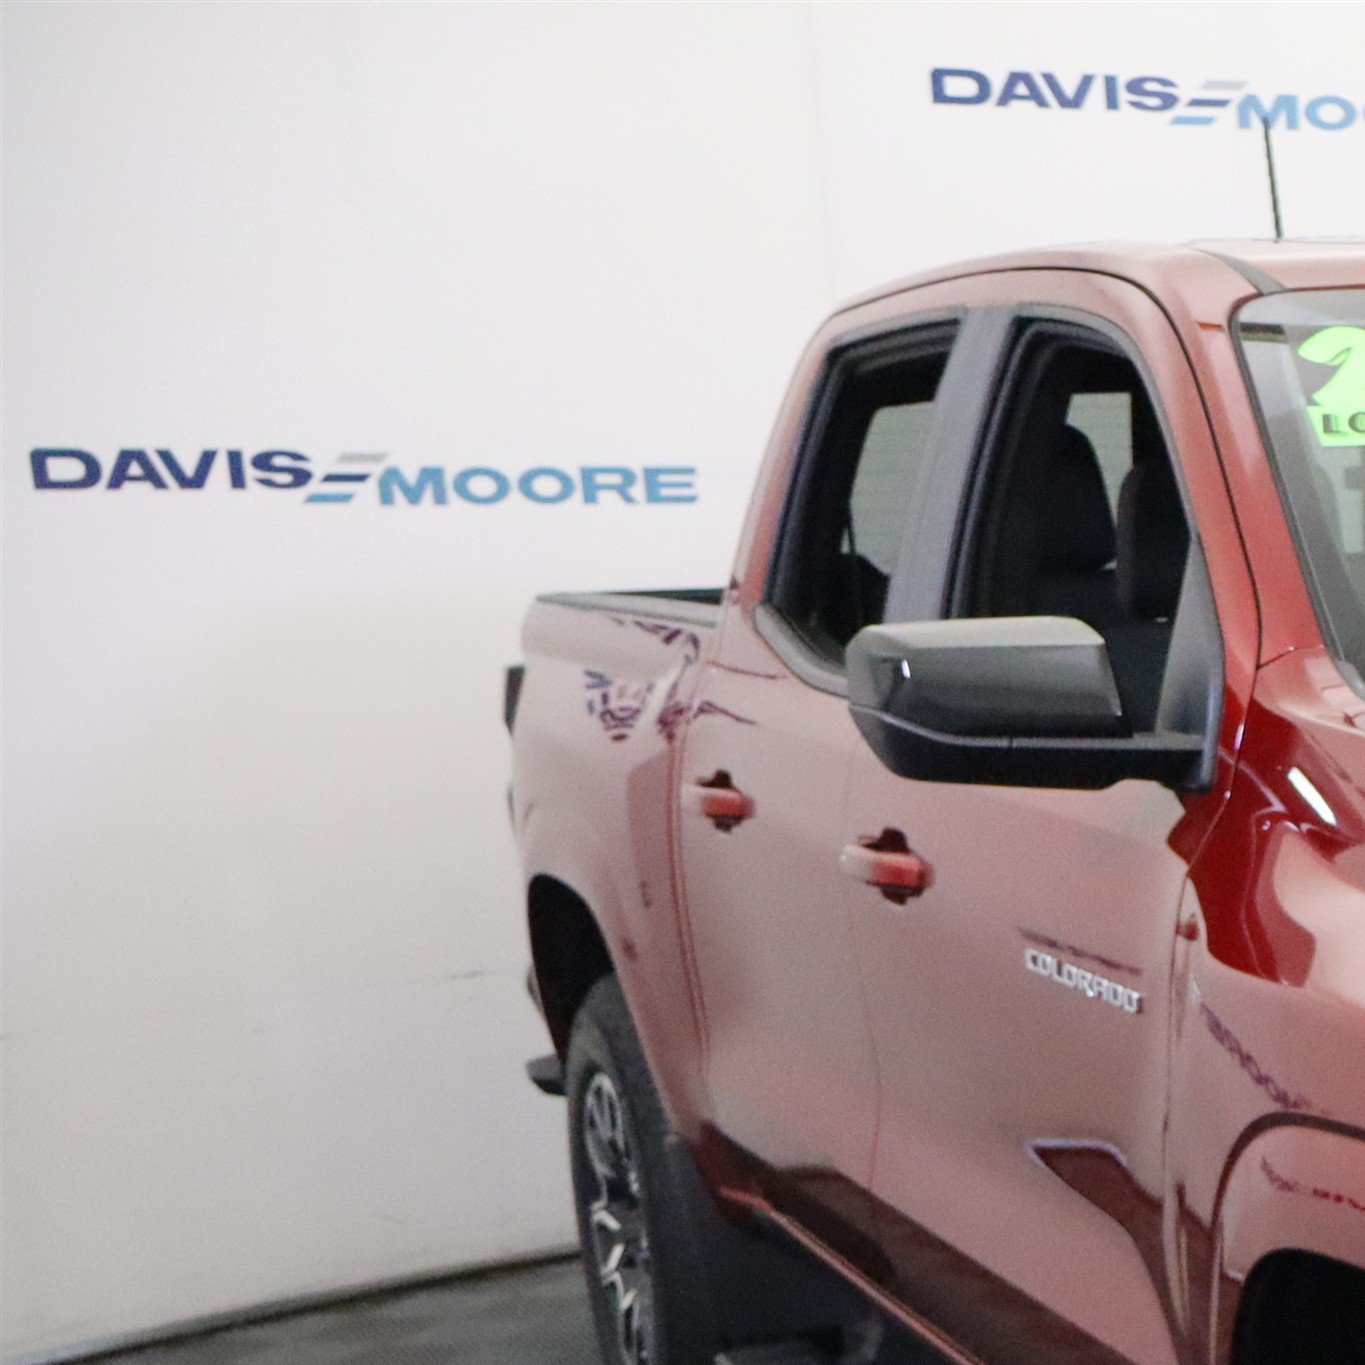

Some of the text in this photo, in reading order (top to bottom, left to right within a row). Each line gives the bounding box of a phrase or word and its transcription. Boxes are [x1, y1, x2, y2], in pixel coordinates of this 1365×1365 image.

[931, 67, 1180, 112] DAVIS
[28, 446, 698, 506] DAVIS MOORE
[1026, 948, 1141, 1014] COLORADO
